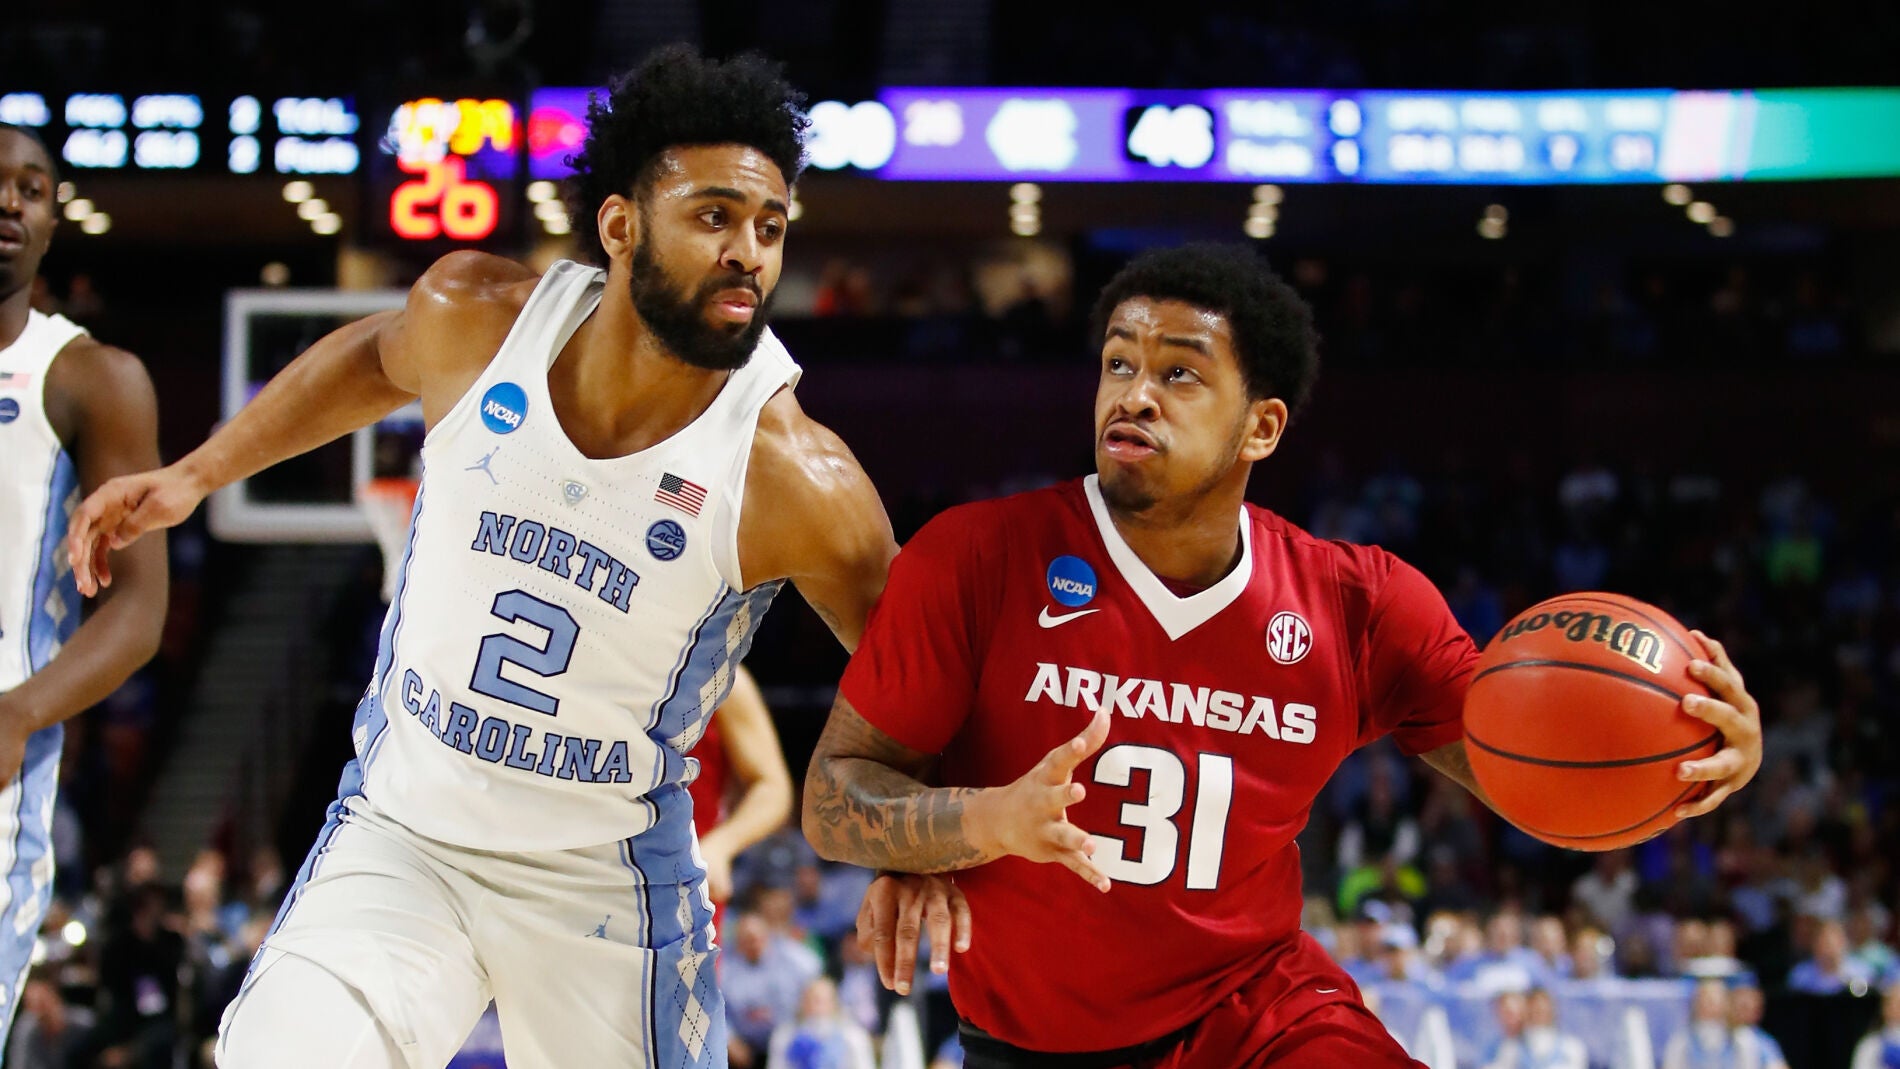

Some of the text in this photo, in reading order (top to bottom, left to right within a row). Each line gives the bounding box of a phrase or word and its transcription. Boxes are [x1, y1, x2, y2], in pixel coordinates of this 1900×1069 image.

[484, 401, 521, 428] NCAA
[471, 511, 640, 614] NORTH
[654, 531, 683, 549] ACC
[1053, 577, 1093, 598] NCAA
[468, 588, 581, 717] 2
[1270, 616, 1308, 661] SEC
[1501, 610, 1665, 674] Wilson
[401, 668, 633, 784] CAROLINA
[1024, 662, 1317, 745] ARKANSAS
[1090, 743, 1233, 891] 31
